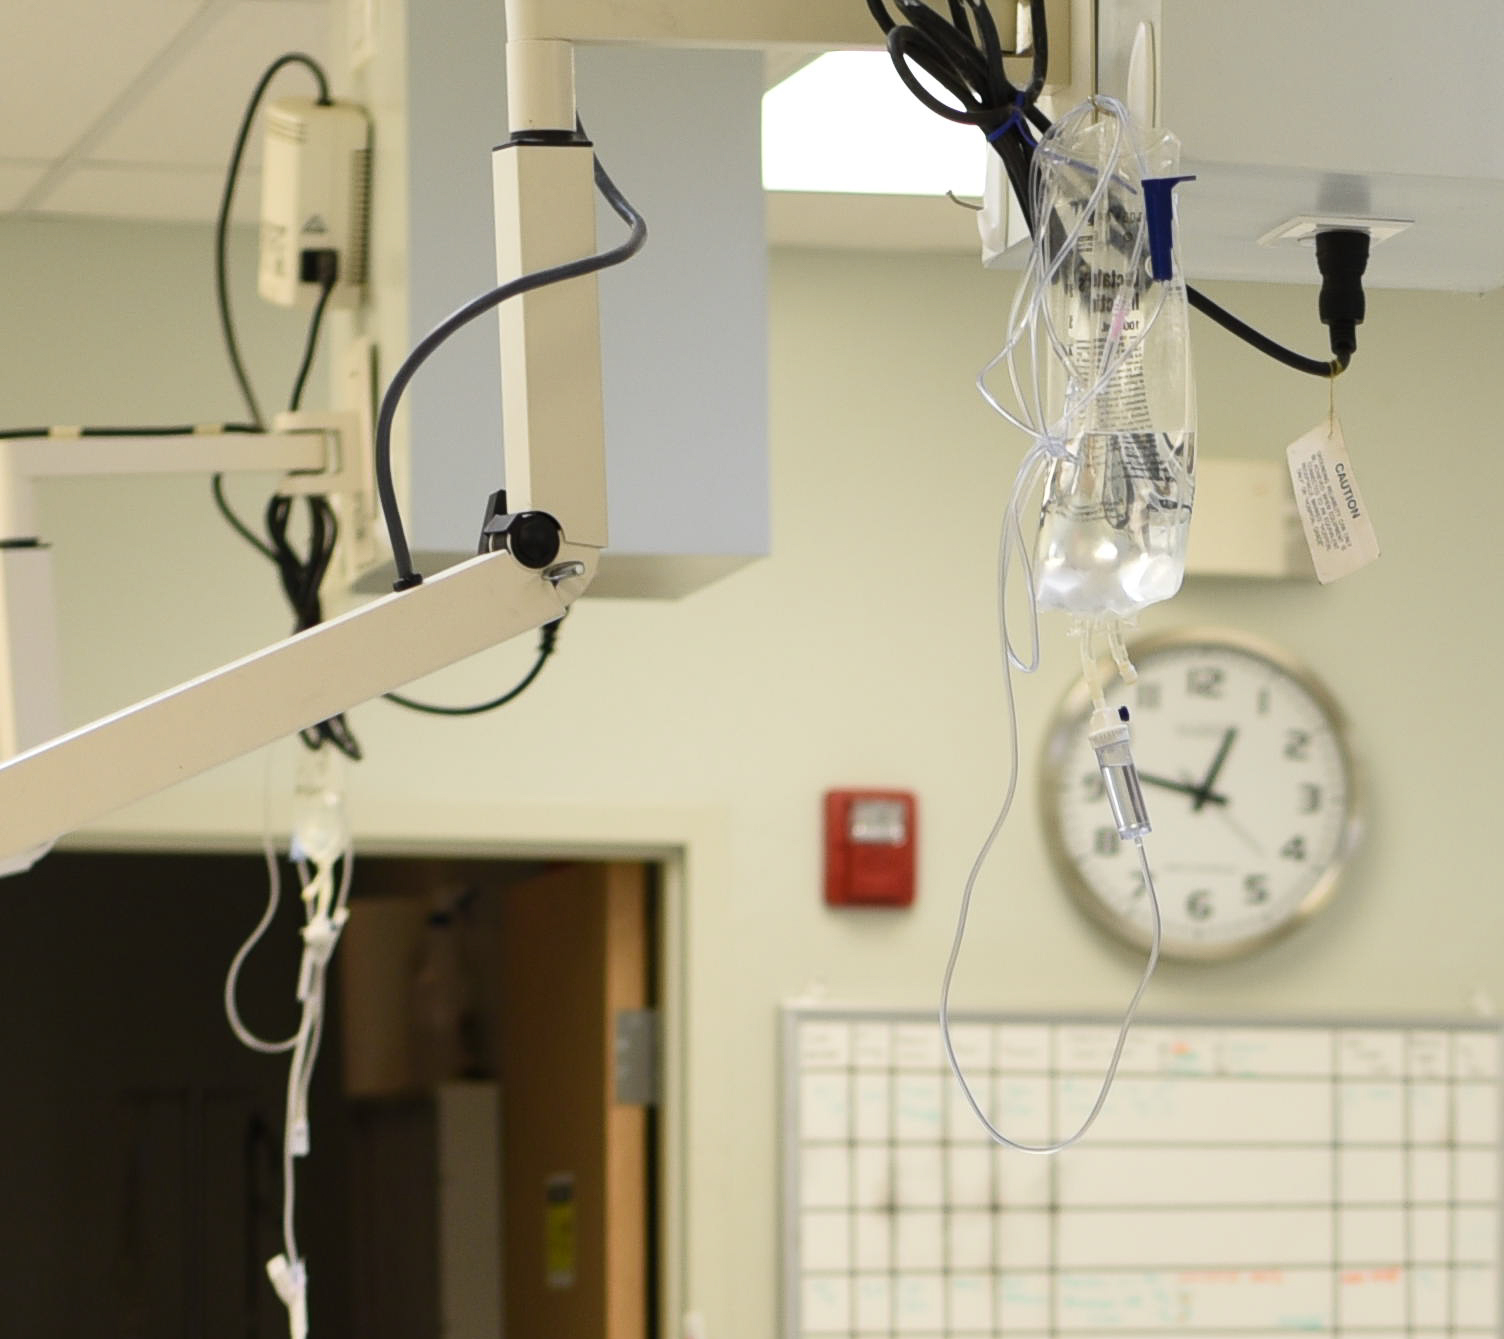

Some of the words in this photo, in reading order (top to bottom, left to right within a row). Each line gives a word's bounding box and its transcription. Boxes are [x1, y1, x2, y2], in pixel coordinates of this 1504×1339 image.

[1335, 463, 1361, 519] CAUTION
[1186, 666, 1223, 700] 12
[1284, 729, 1313, 761] 2
[1300, 782, 1322, 813] 3
[1280, 834, 1306, 862] 4
[1186, 888, 1213, 920] 6
[1244, 873, 1268, 905] 5
